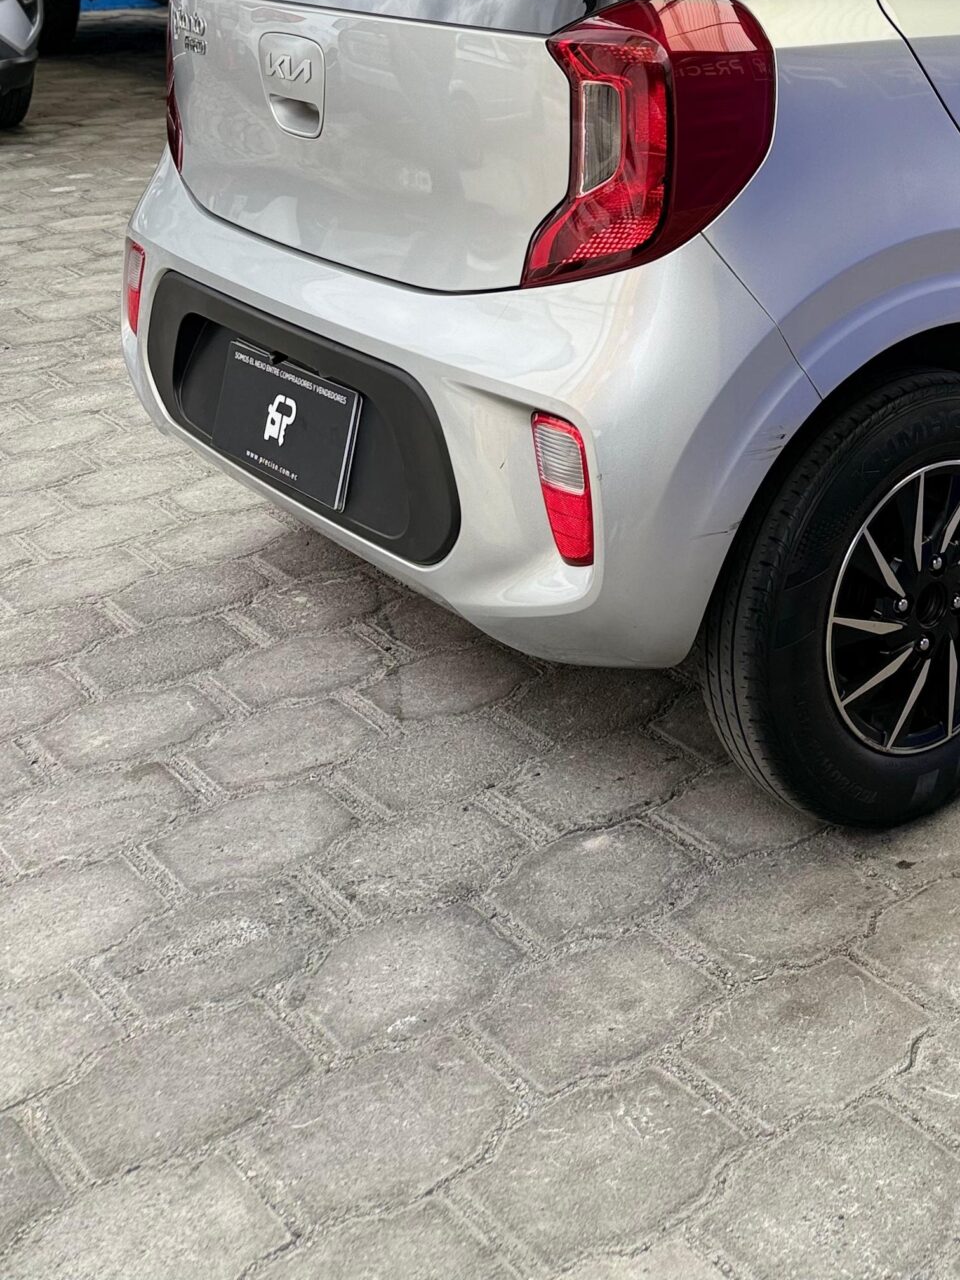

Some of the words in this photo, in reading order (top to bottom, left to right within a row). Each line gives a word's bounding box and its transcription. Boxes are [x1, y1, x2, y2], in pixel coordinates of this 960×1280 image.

[234, 351, 250, 364] SOMOS
[266, 364, 280, 377] ENTRE
[280, 370, 313, 390] COMPRADORES
[315, 384, 347, 405] VENDEDORES
[246, 450, 298, 481] www.preciso.com.ec
